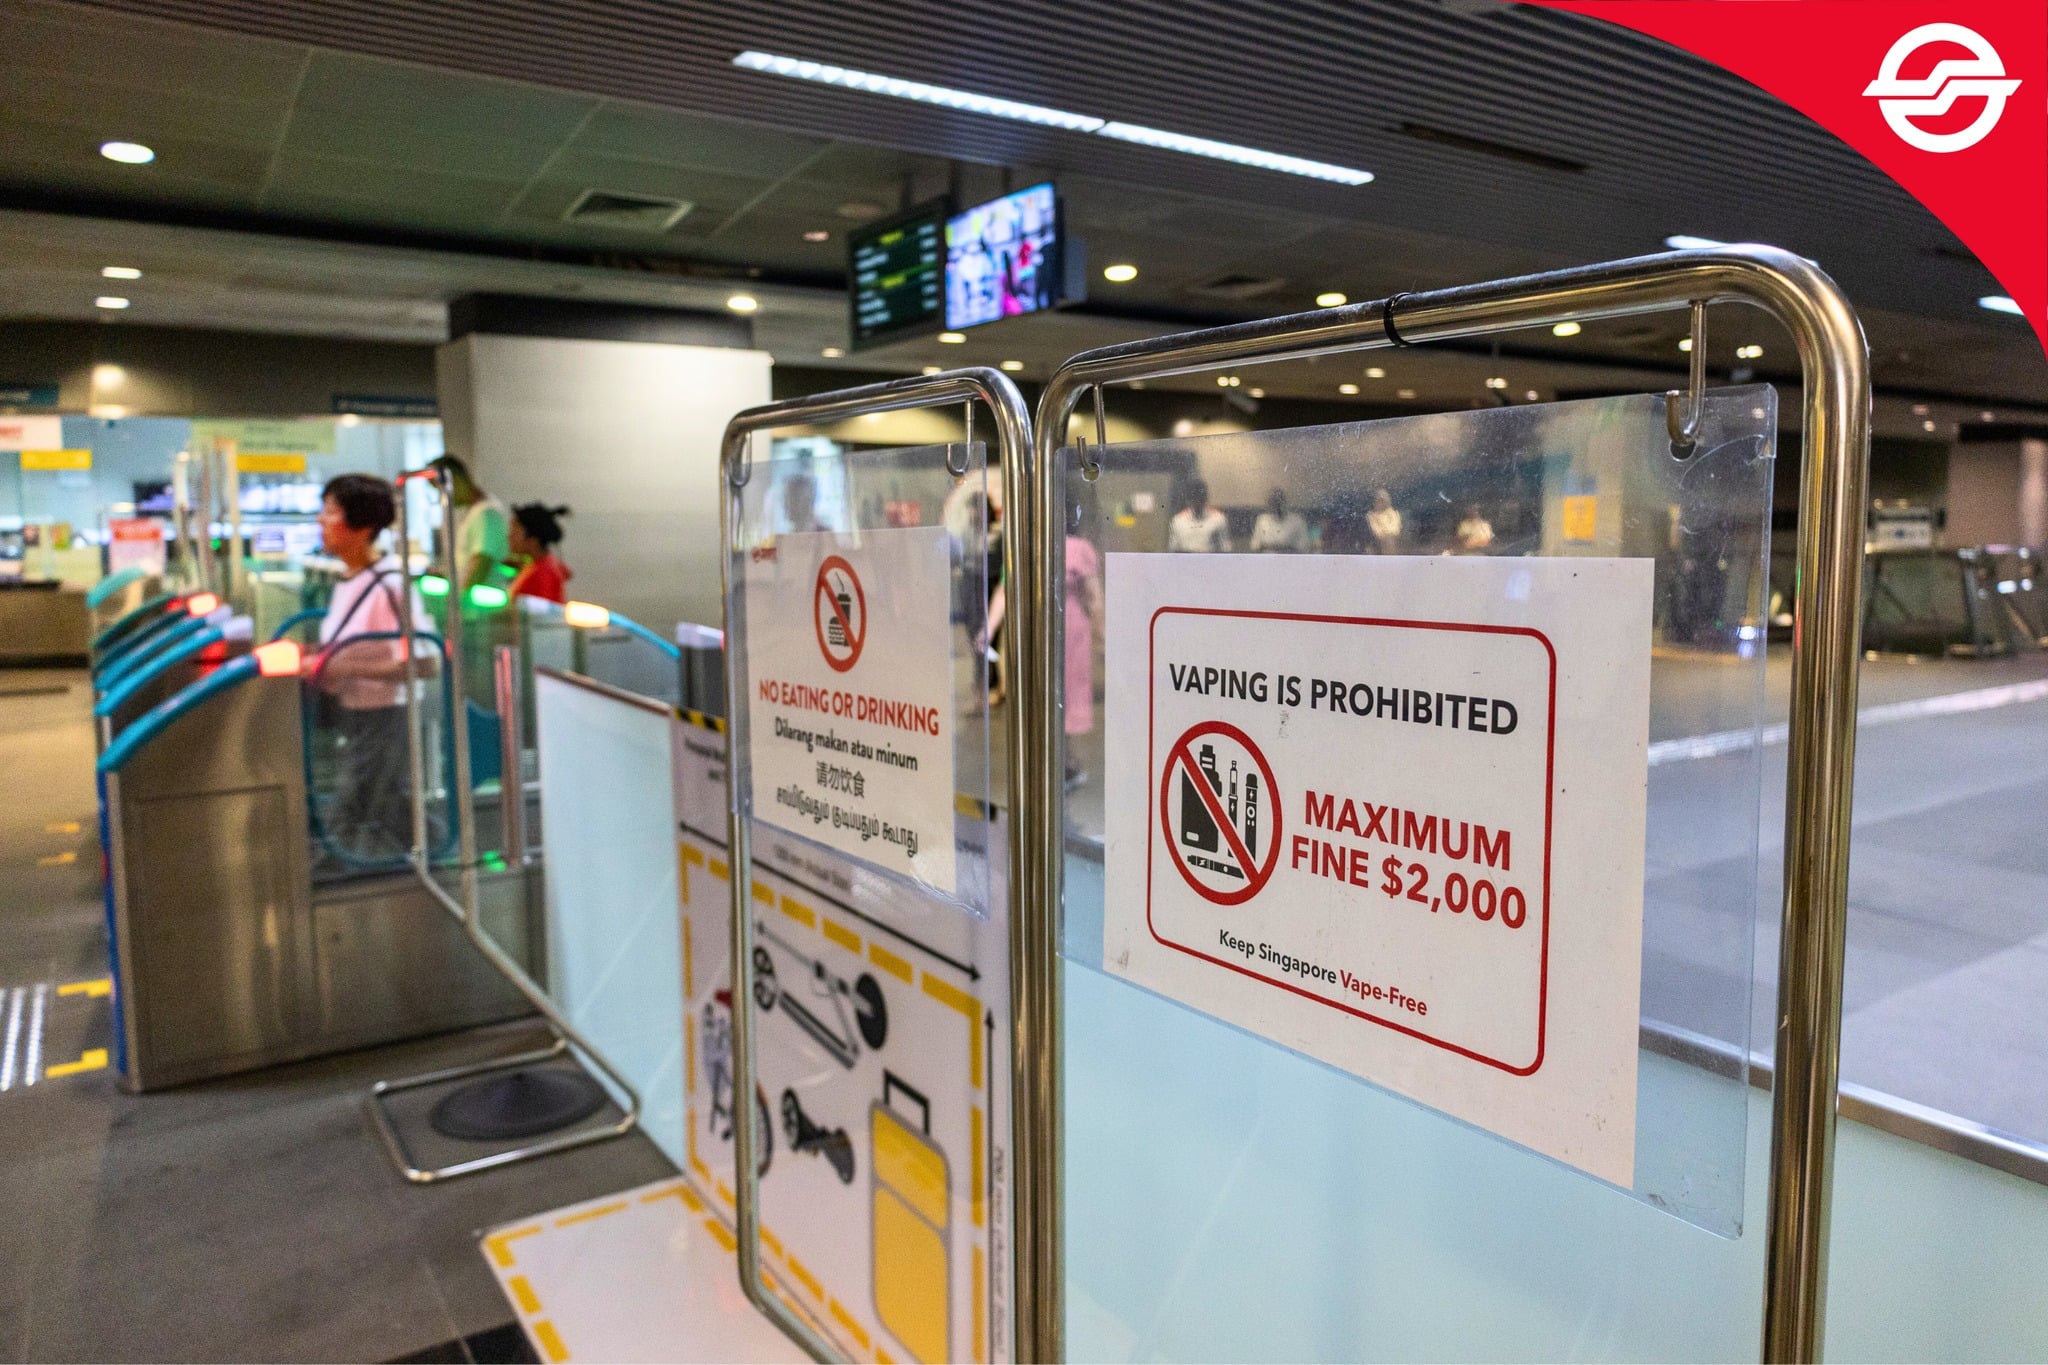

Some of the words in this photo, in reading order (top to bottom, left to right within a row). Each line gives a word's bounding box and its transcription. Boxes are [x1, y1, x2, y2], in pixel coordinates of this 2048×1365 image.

[759, 679, 780, 704] NO
[782, 681, 829, 713] EATING
[832, 691, 854, 719] OR
[857, 695, 940, 736] DRINKING
[1169, 663, 1268, 703] VAPING
[1277, 674, 1302, 707] IS
[1310, 678, 1519, 736] PROHIBITED
[775, 716, 814, 753] Dilarang
[815, 729, 849, 753] makan
[851, 740, 873, 760] atau
[876, 742, 919, 771] minum
[816, 760, 866, 799] 请勿饮食
[1305, 790, 1511, 872] MAXIMUM
[1291, 834, 1370, 889] FINE
[1380, 853, 1527, 930] $2,000
[1219, 928, 1255, 959] Keep
[1258, 942, 1337, 984] Singapore
[1339, 969, 1428, 1016] Vape-Free
